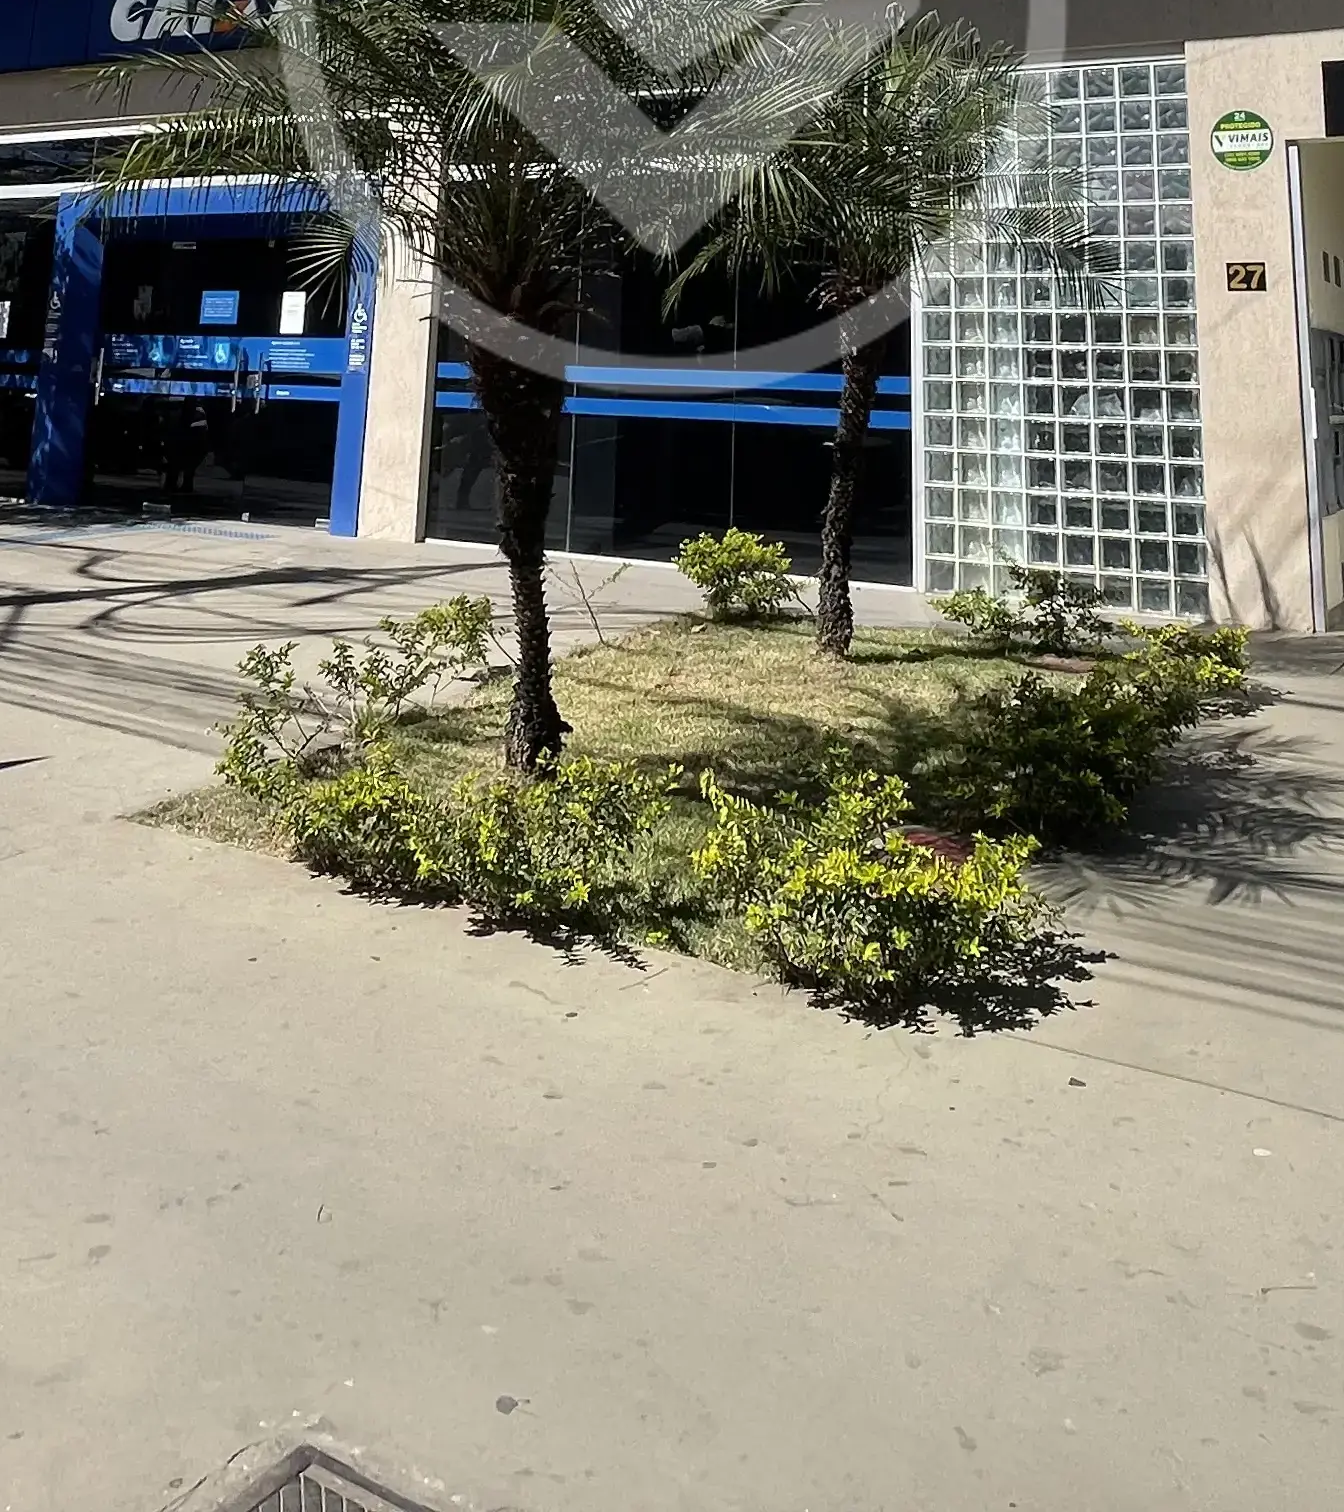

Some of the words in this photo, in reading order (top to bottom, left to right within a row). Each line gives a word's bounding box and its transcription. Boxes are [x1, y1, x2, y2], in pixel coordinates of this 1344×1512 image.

[1220, 121, 1261, 130] PROTEGIDO
[1228, 132, 1269, 144] VIMAIS
[1227, 265, 1264, 291] 27
